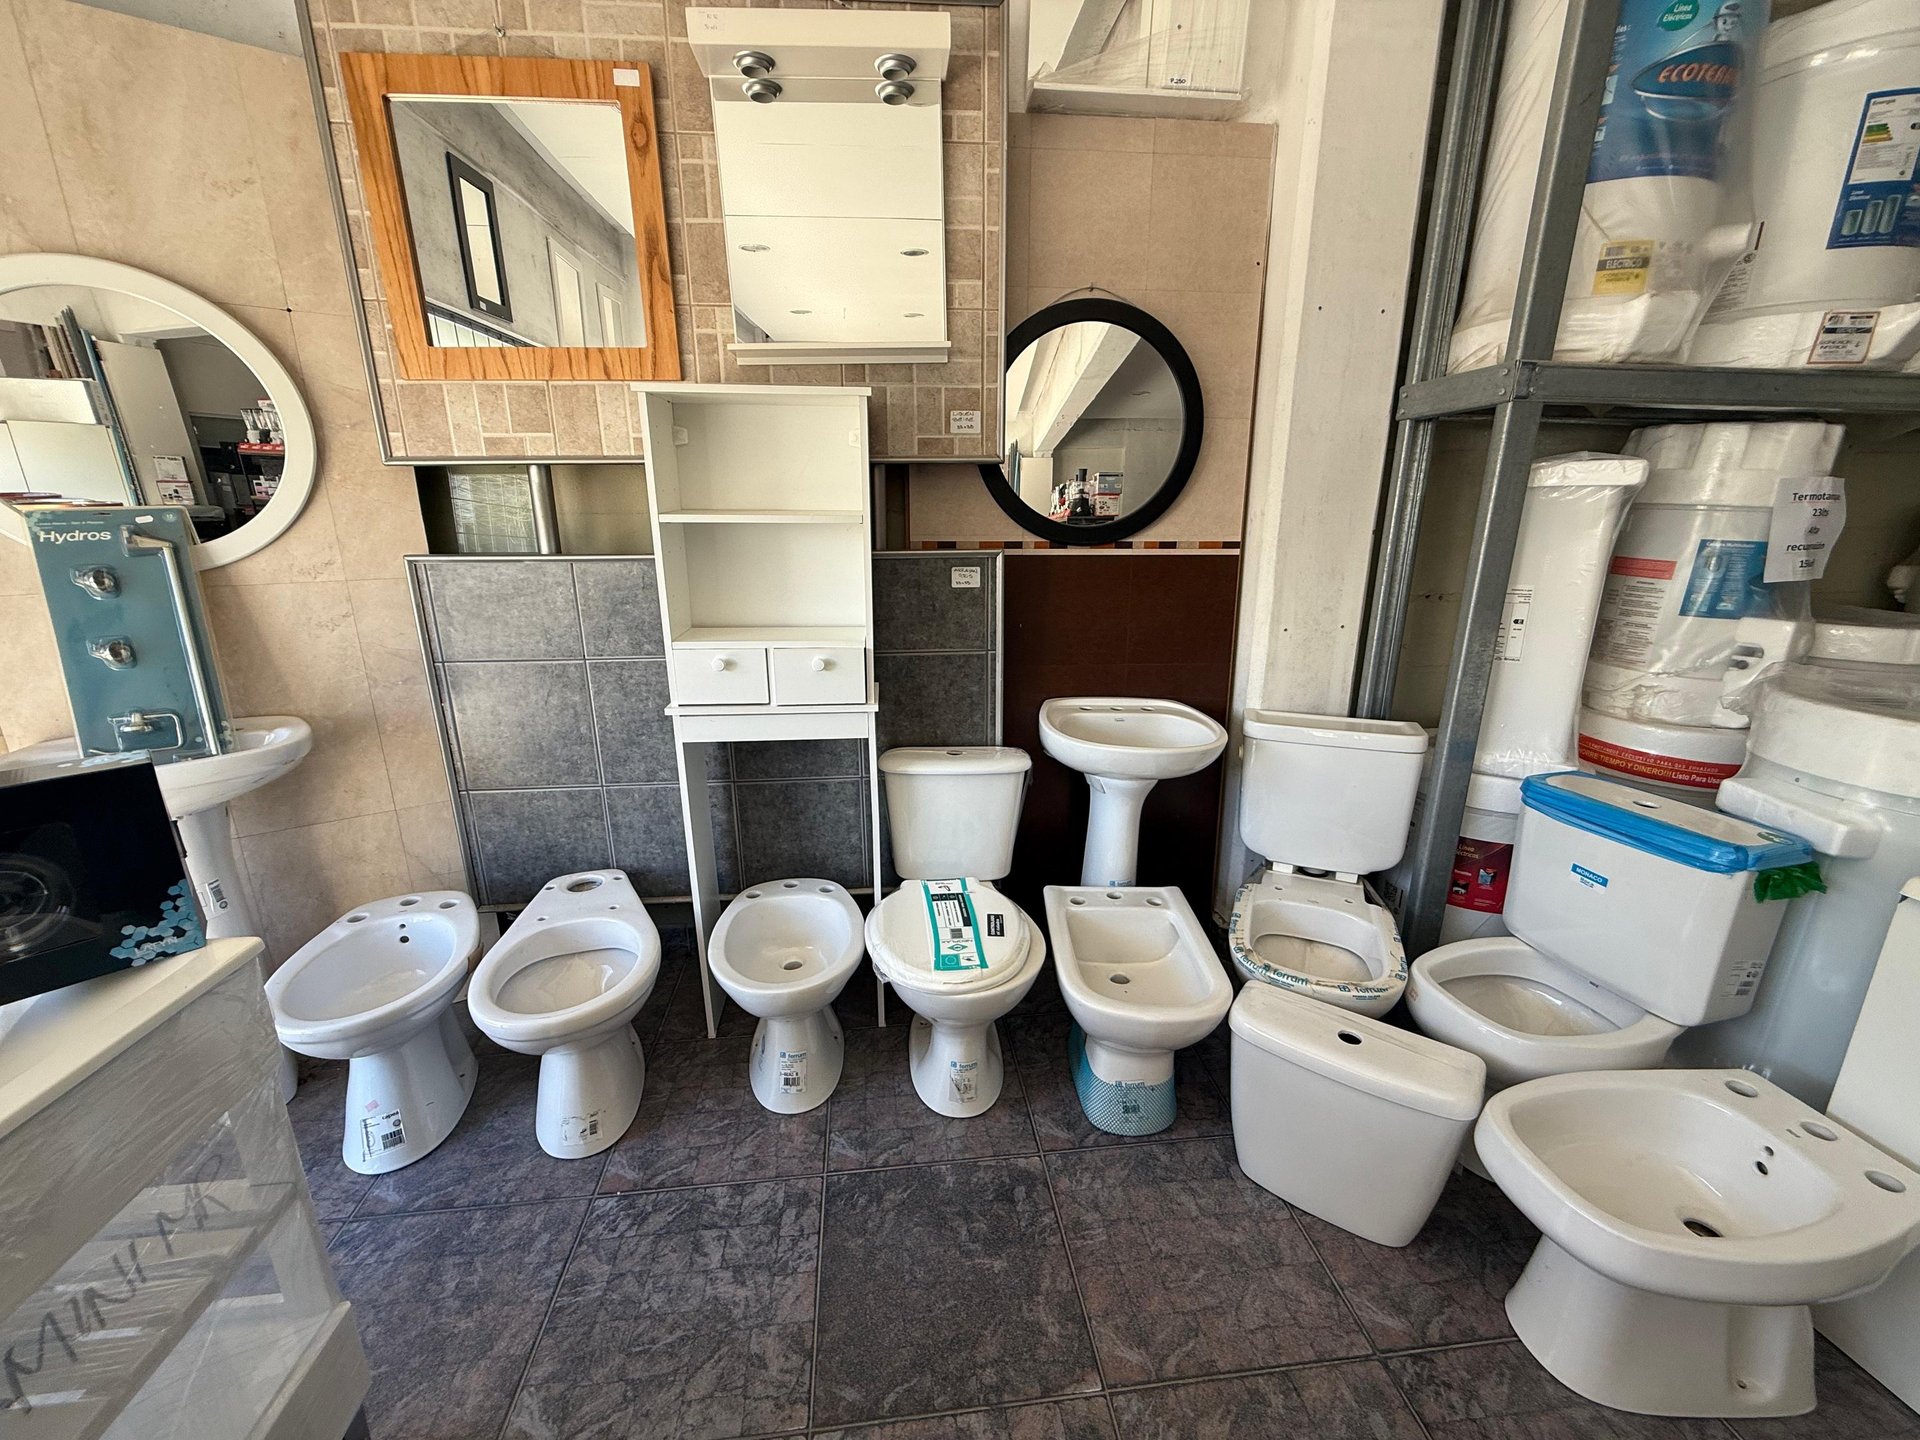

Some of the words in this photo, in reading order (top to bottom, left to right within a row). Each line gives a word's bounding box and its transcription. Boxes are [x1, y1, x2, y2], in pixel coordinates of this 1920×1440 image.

[39, 529, 112, 545] Hydros
[1599, 754, 1626, 767] TIEMPO
[1671, 771, 1690, 781] Listo
[1690, 774, 1708, 783] Para
[1575, 867, 1604, 884] MONACO
[1272, 968, 1309, 986] ferrum
